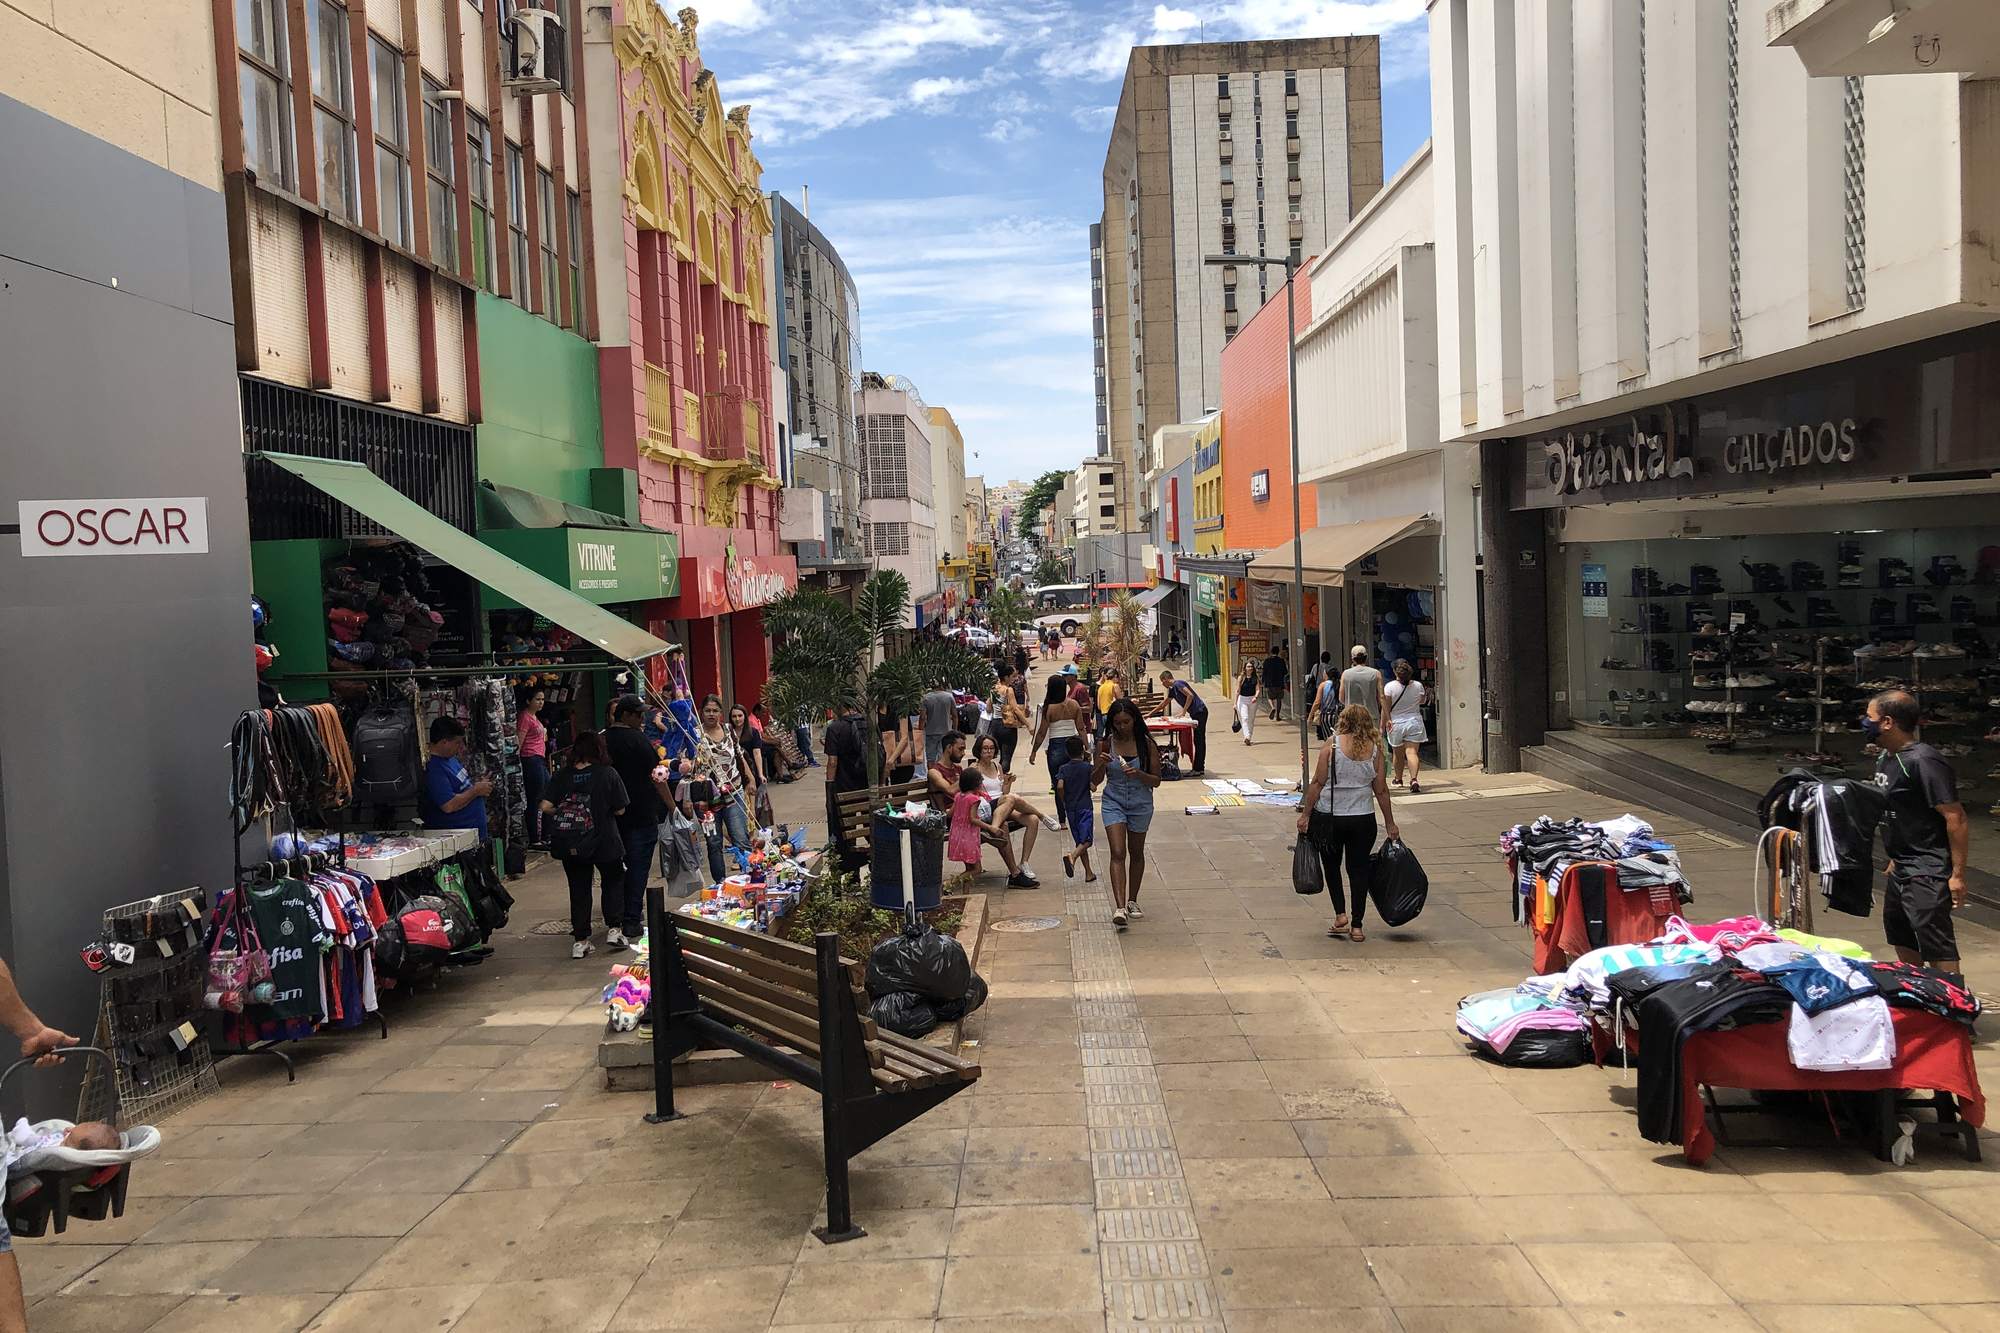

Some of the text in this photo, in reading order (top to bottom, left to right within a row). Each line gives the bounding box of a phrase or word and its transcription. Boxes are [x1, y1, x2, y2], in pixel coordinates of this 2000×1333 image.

[1724, 418, 1856, 476] CALÇADOS
[37, 507, 191, 547] OSCAR
[577, 543, 617, 571] VITRINE
[1240, 640, 1266, 648] SUPER
